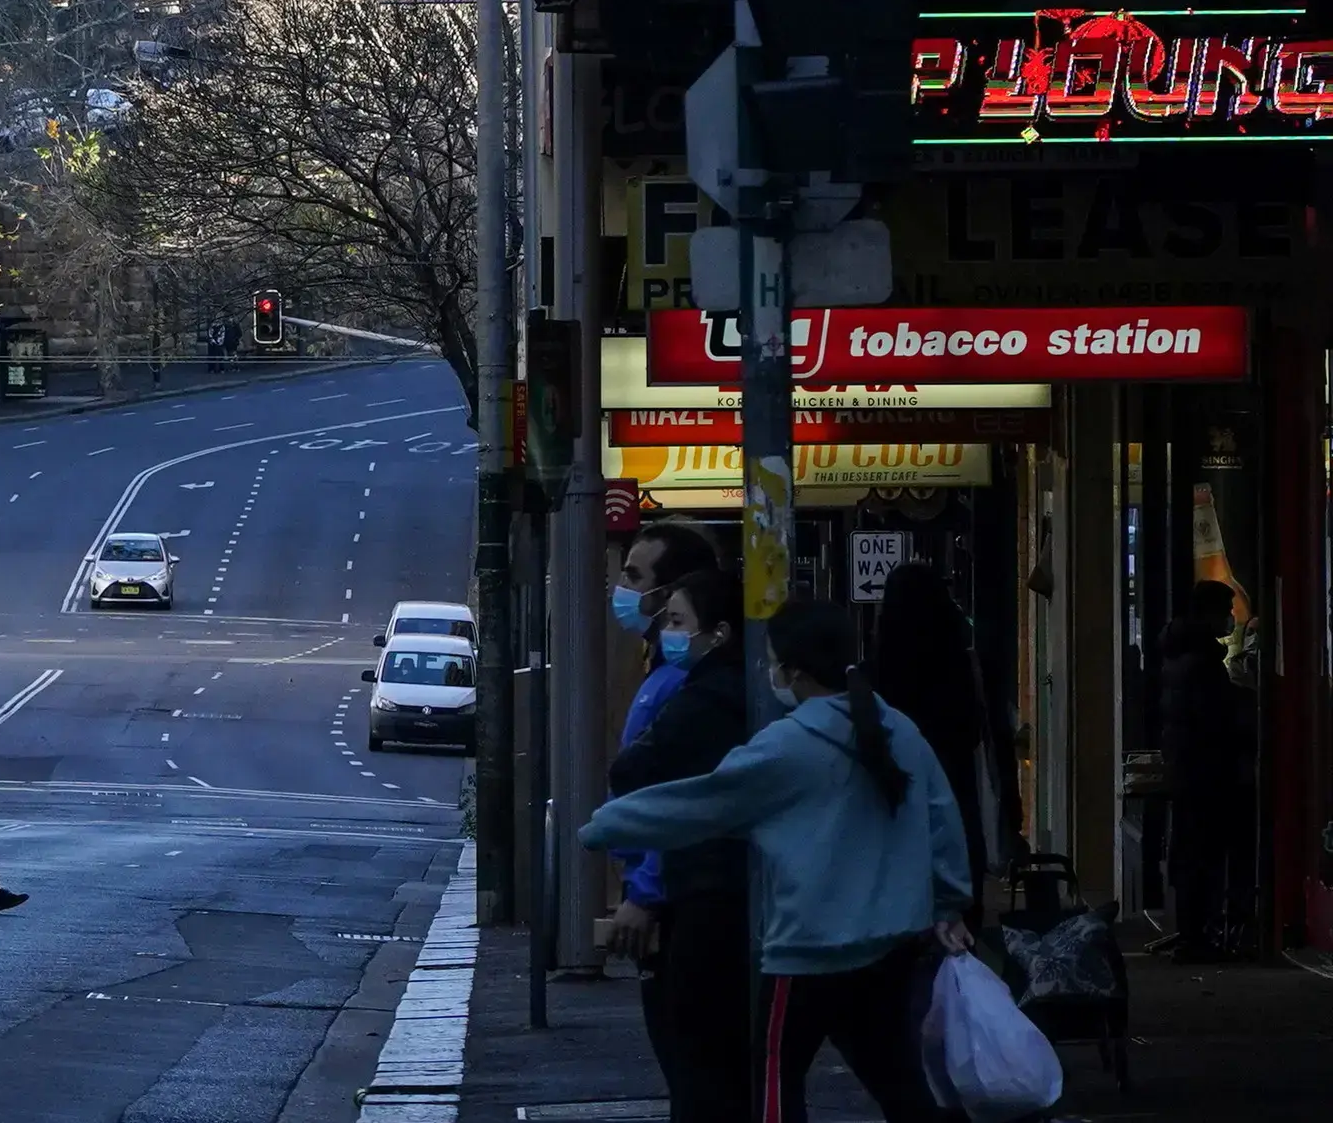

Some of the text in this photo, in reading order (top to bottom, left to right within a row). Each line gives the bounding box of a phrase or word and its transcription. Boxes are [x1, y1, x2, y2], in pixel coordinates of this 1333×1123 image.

[849, 323, 1027, 358] tobacco
[1047, 319, 1201, 356] station
[793, 398, 844, 406] HICKEN
[868, 397, 918, 406] DINING
[814, 471, 918, 482] THAI DESSERT CAFE
[860, 539, 896, 554] ONE
[858, 560, 897, 576] WAY
